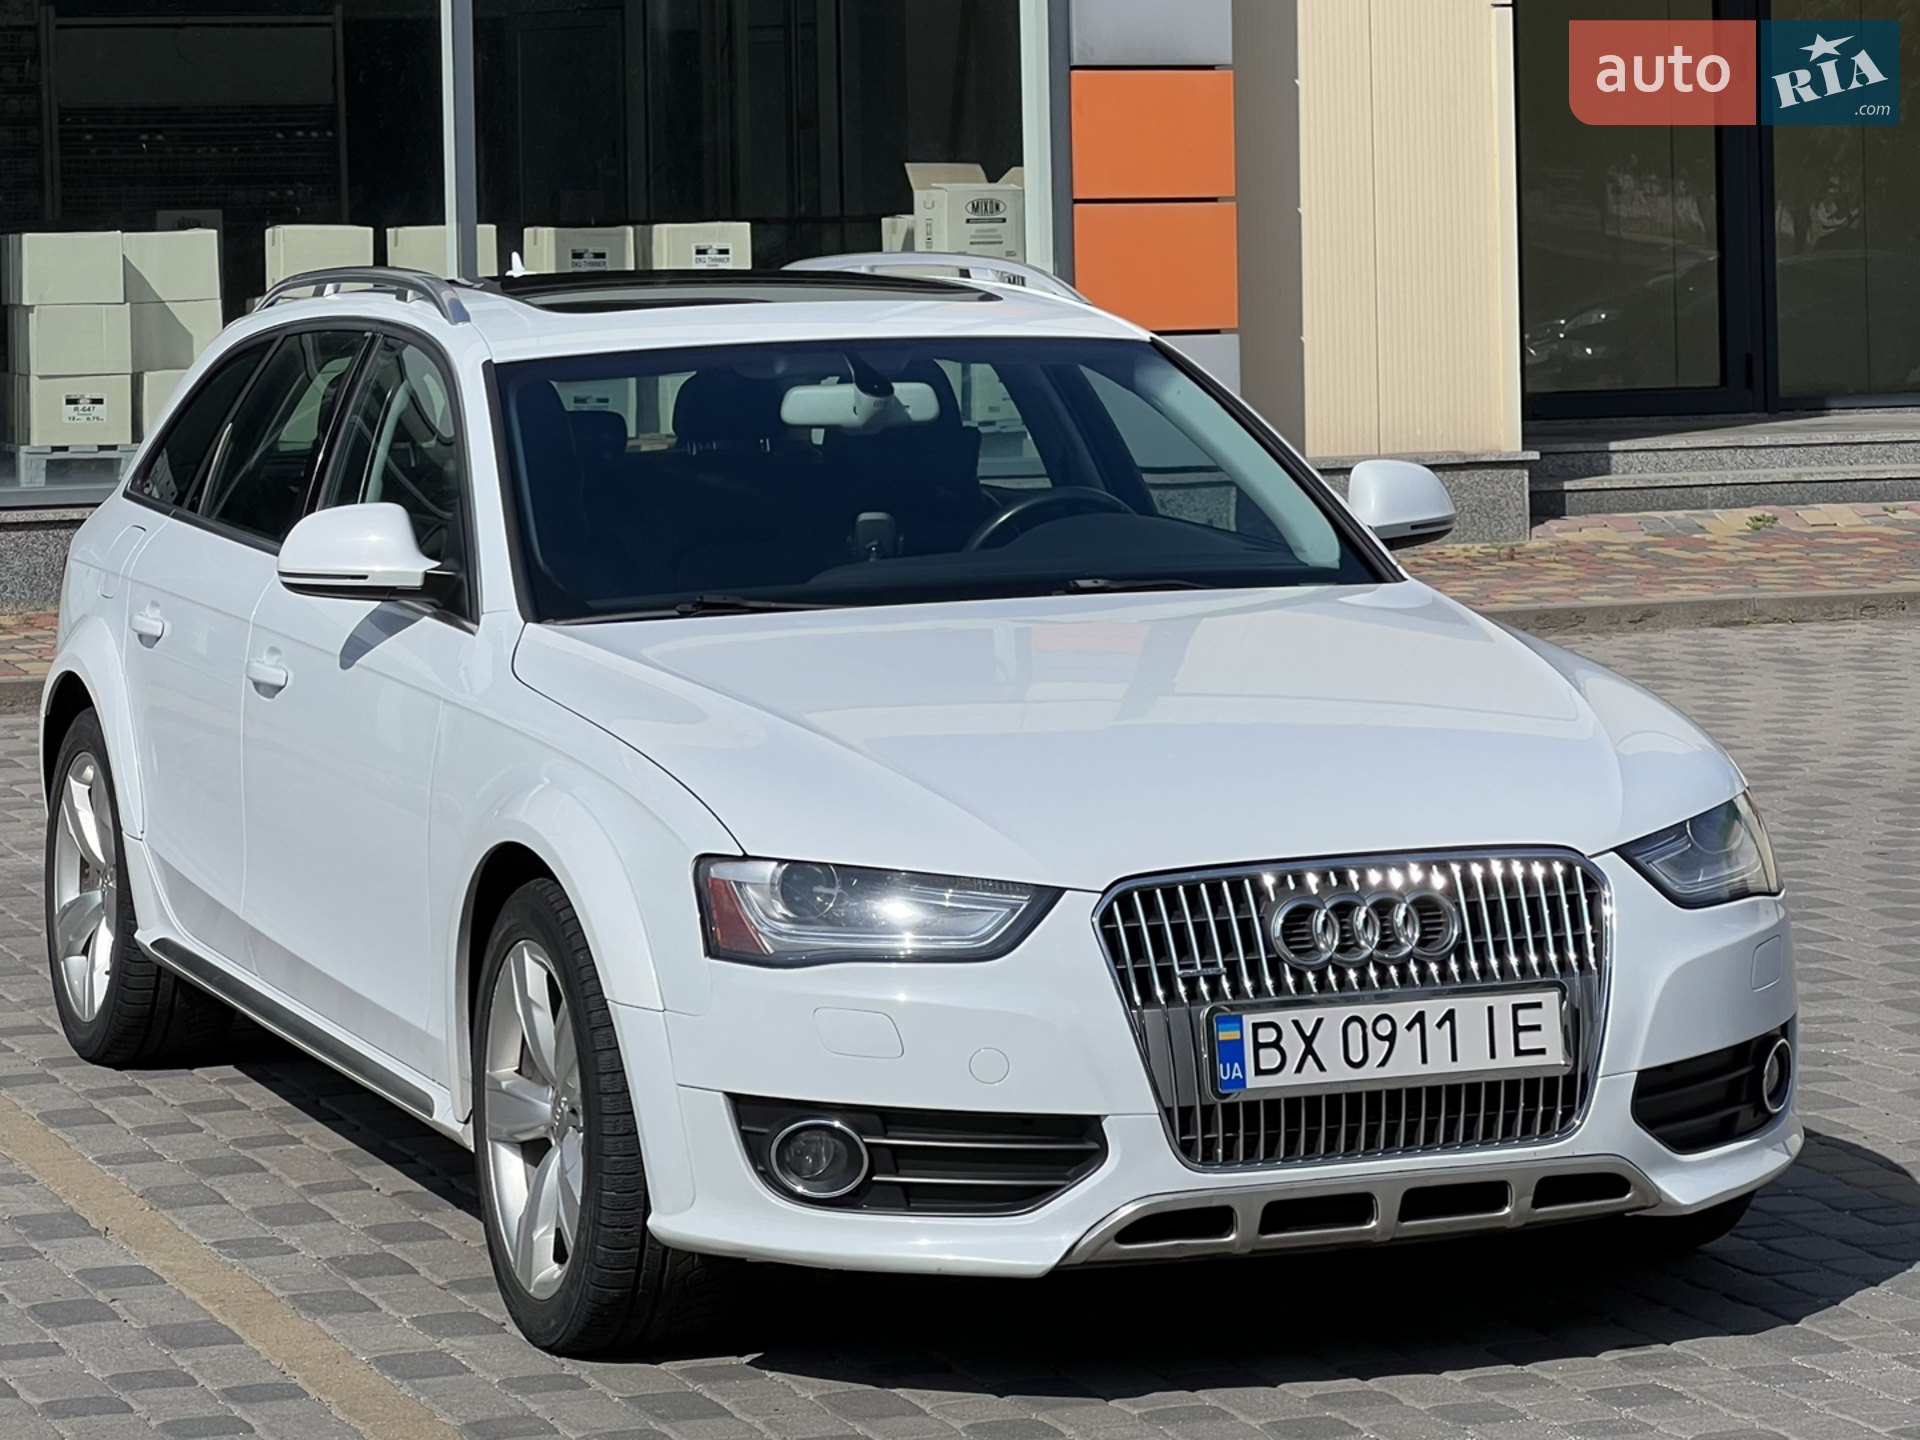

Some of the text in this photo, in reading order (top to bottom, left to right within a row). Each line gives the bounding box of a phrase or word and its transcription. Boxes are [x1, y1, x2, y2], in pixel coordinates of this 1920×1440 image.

[971, 200, 1001, 215] MIXON
[1251, 1001, 1548, 1077] BX 0911 IE
[1219, 1062, 1244, 1081] UA
